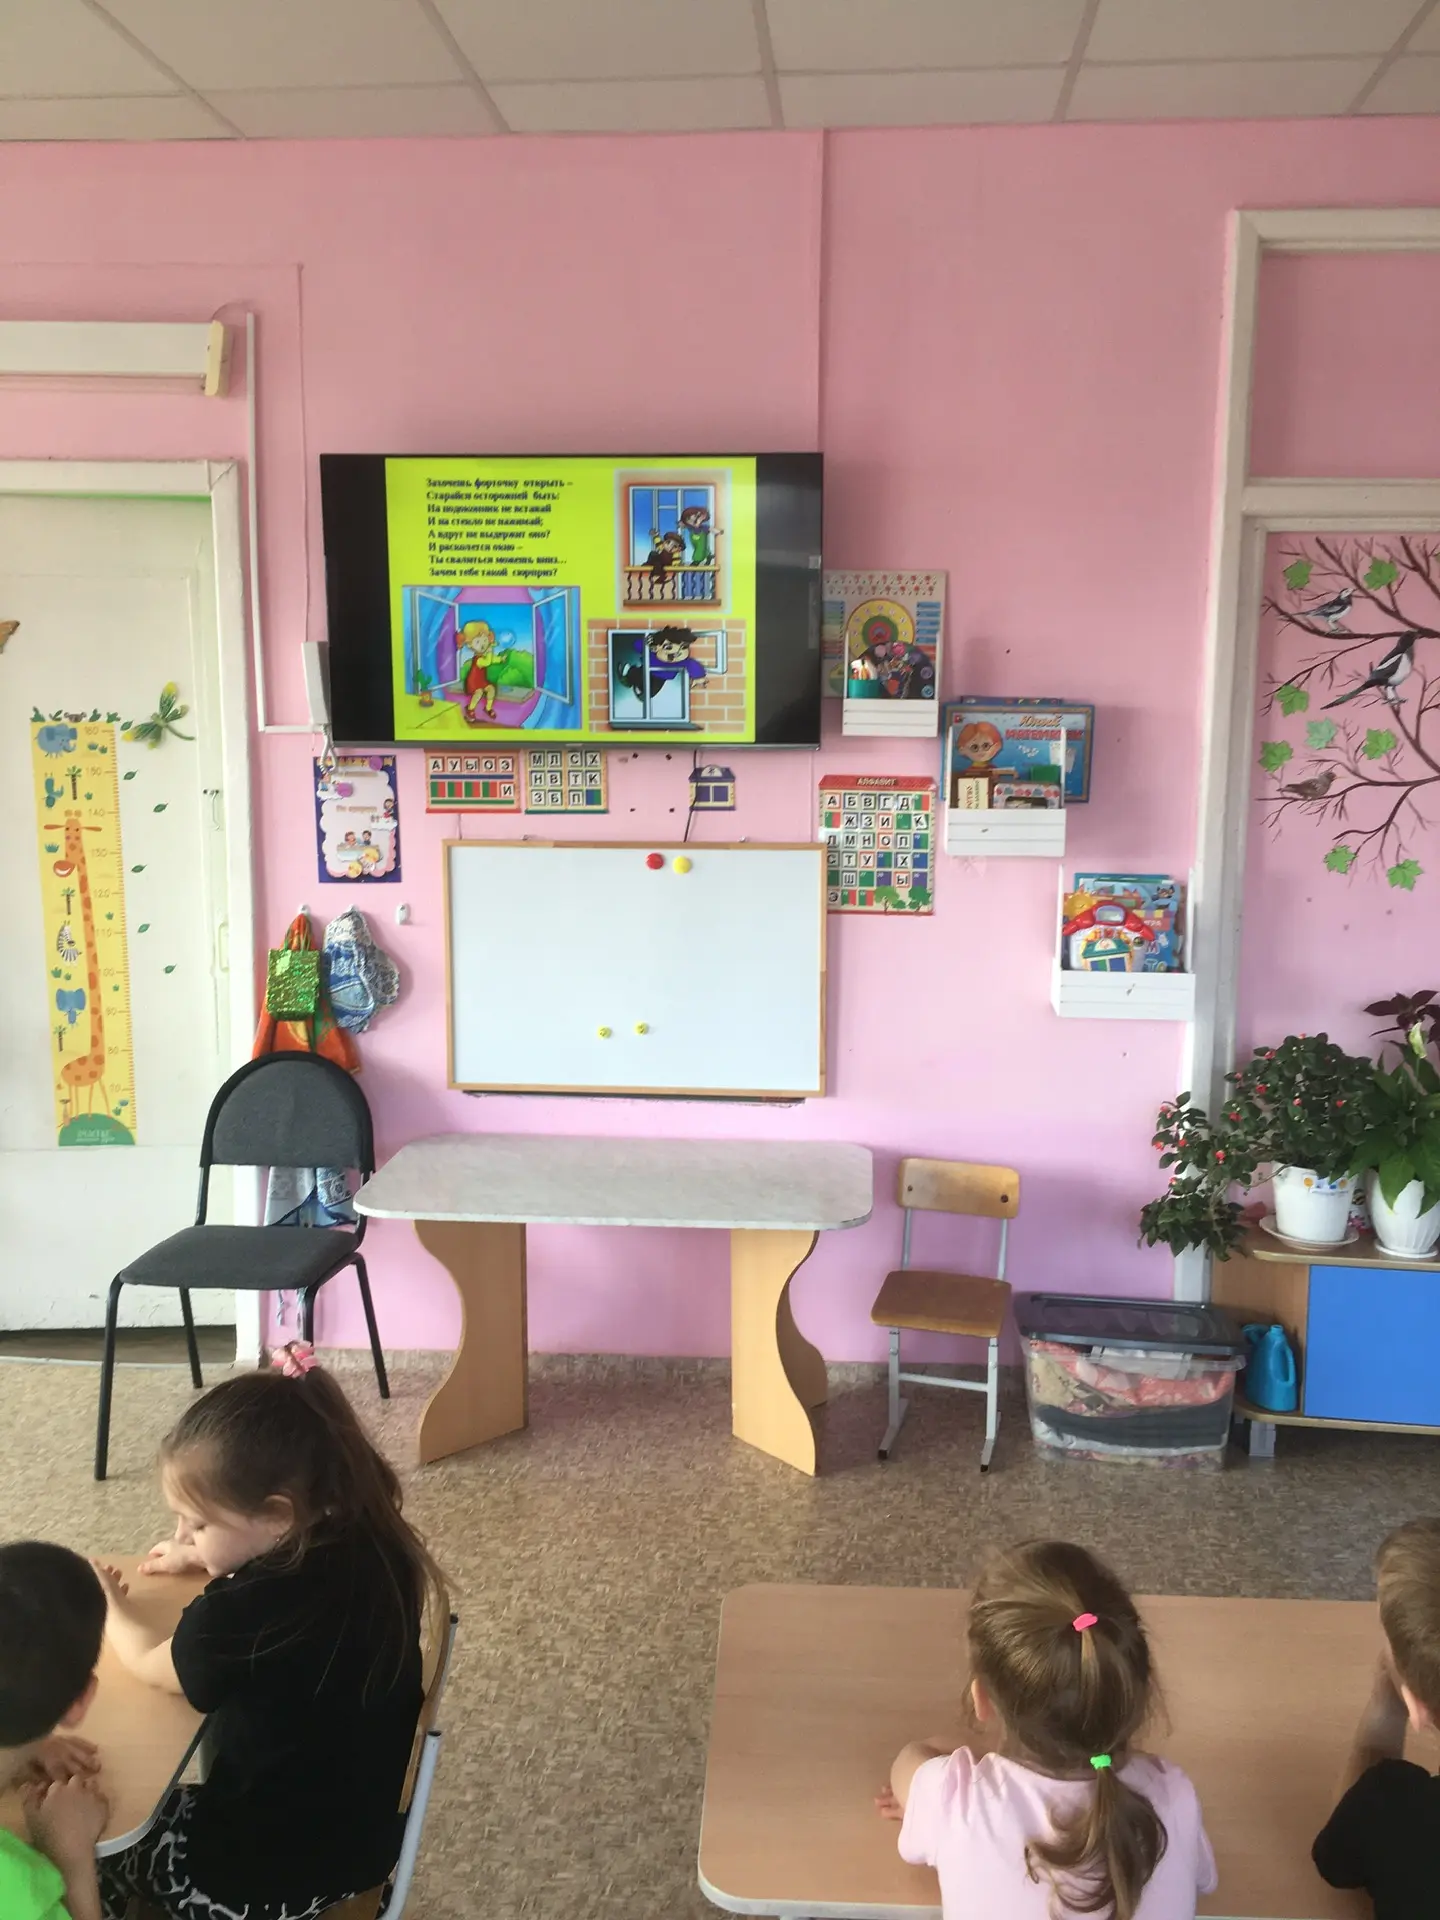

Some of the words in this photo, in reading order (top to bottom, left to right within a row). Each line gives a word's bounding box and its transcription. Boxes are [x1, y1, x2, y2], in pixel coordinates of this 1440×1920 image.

[532, 754, 543, 766] М
[549, 754, 559, 765] Л
[570, 753, 579, 765] С
[589, 753, 599, 766] Х
[431, 760, 441, 771] А
[449, 760, 459, 772] У
[465, 760, 477, 771] Ы
[483, 760, 494, 771] О
[501, 760, 510, 771] Э
[533, 774, 543, 785] Н
[550, 774, 559, 784] В
[572, 774, 581, 784] Т
[589, 773, 599, 785] К
[503, 785, 512, 796] И
[534, 792, 543, 803] З
[551, 792, 560, 803] Б
[572, 793, 581, 803] П
[828, 795, 837, 805] А
[848, 796, 857, 806] Б
[863, 797, 873, 807] В
[883, 797, 891, 806] Г
[900, 798, 909, 810] Д
[844, 815, 855, 827] Ж
[863, 816, 873, 827] З
[880, 816, 890, 827] И
[914, 816, 923, 826] К
[826, 834, 837, 846] Л
[844, 835, 855, 846] М
[862, 835, 872, 846] Н
[880, 835, 891, 846] О
[899, 835, 908, 846] П
[844, 854, 854, 865] Т
[863, 854, 872, 866] У
[899, 855, 909, 866] Х
[844, 873, 855, 884] Ш
[896, 874, 909, 885] Ы
